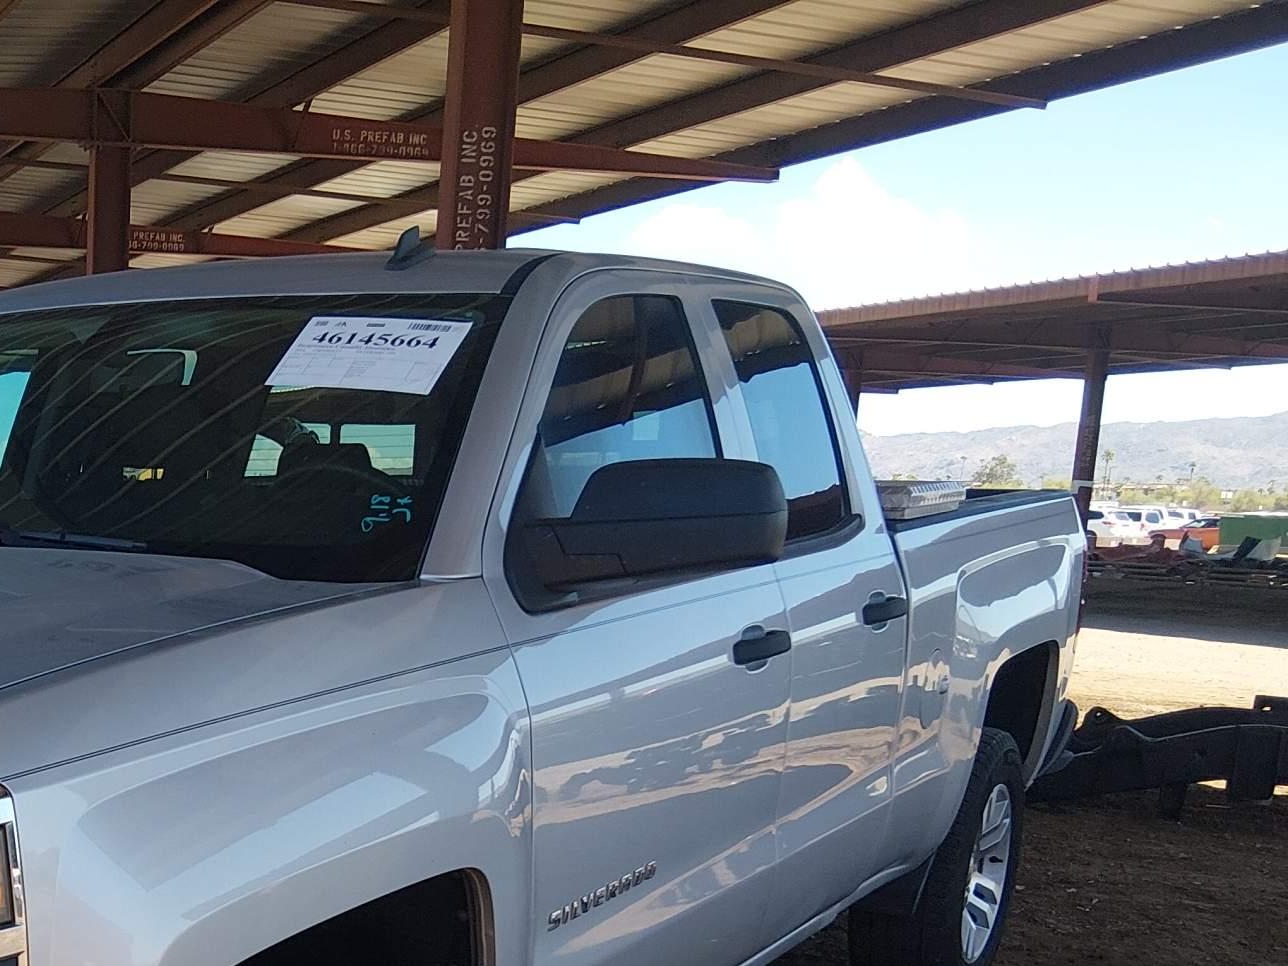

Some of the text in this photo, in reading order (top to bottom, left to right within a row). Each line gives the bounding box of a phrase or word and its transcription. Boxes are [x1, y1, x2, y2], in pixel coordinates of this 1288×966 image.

[332, 128, 428, 145] U.S. PREFAB INC
[461, 130, 478, 163] INC
[474, 126, 497, 250] -799-0969
[133, 231, 166, 243] PREFAB
[312, 331, 440, 349] 46145664
[546, 859, 657, 932] SILVERADO
